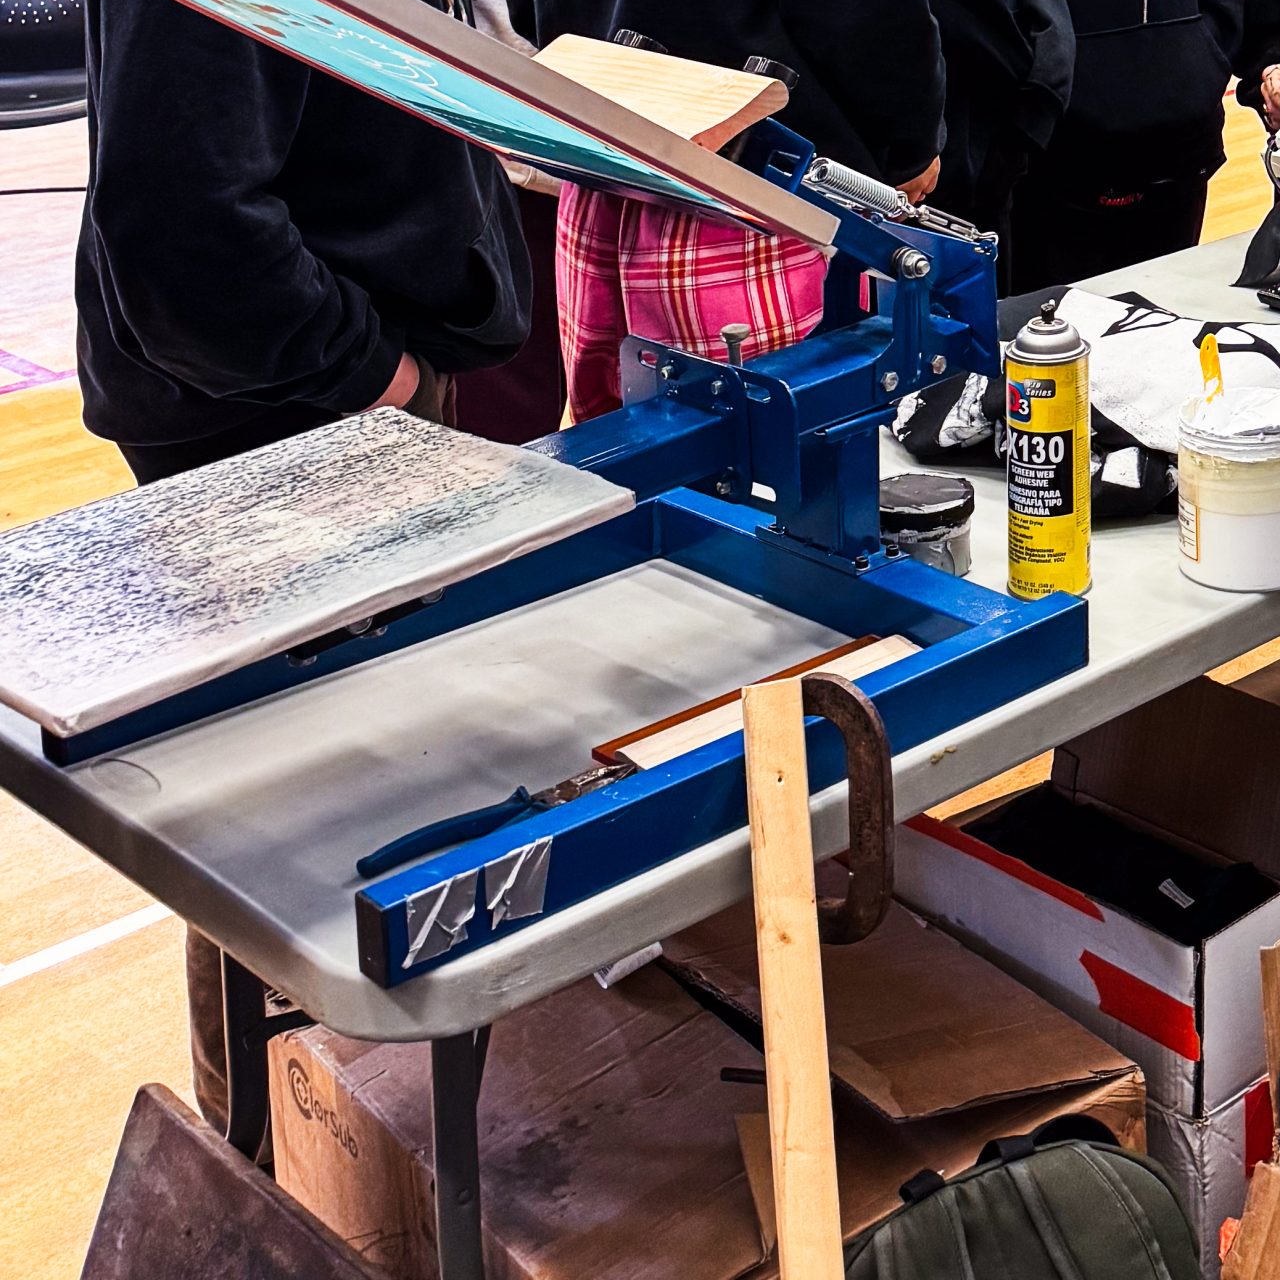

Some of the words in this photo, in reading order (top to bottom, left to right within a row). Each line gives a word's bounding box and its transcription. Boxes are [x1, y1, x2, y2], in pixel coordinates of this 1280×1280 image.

[1026, 388, 1052, 397] Series
[1011, 464, 1035, 478] SCREEN
[1036, 470, 1055, 479] WEB
[1014, 475, 1049, 487] ADHESIVE
[1039, 489, 1061, 498] PARA
[1044, 498, 1063, 507] TIPO
[287, 1058, 358, 1159] ColorSub
